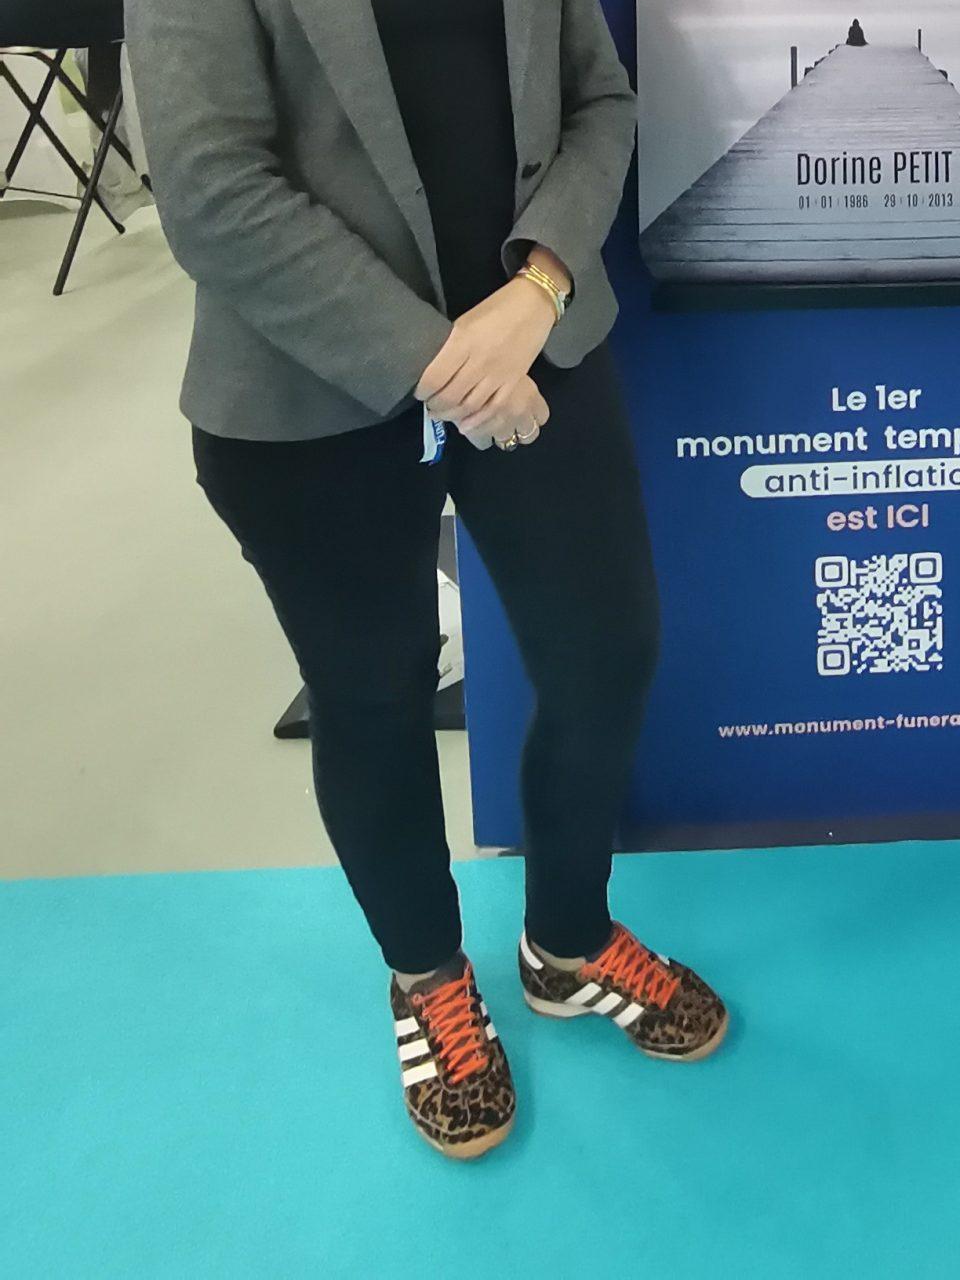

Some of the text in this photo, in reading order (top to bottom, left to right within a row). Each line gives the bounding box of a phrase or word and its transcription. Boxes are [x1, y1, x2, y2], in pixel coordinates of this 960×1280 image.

[797, 150, 953, 186] Dorine PETIT
[831, 384, 922, 412] Le 1er
[676, 426, 868, 458] monument
[826, 503, 929, 532] est ICI
